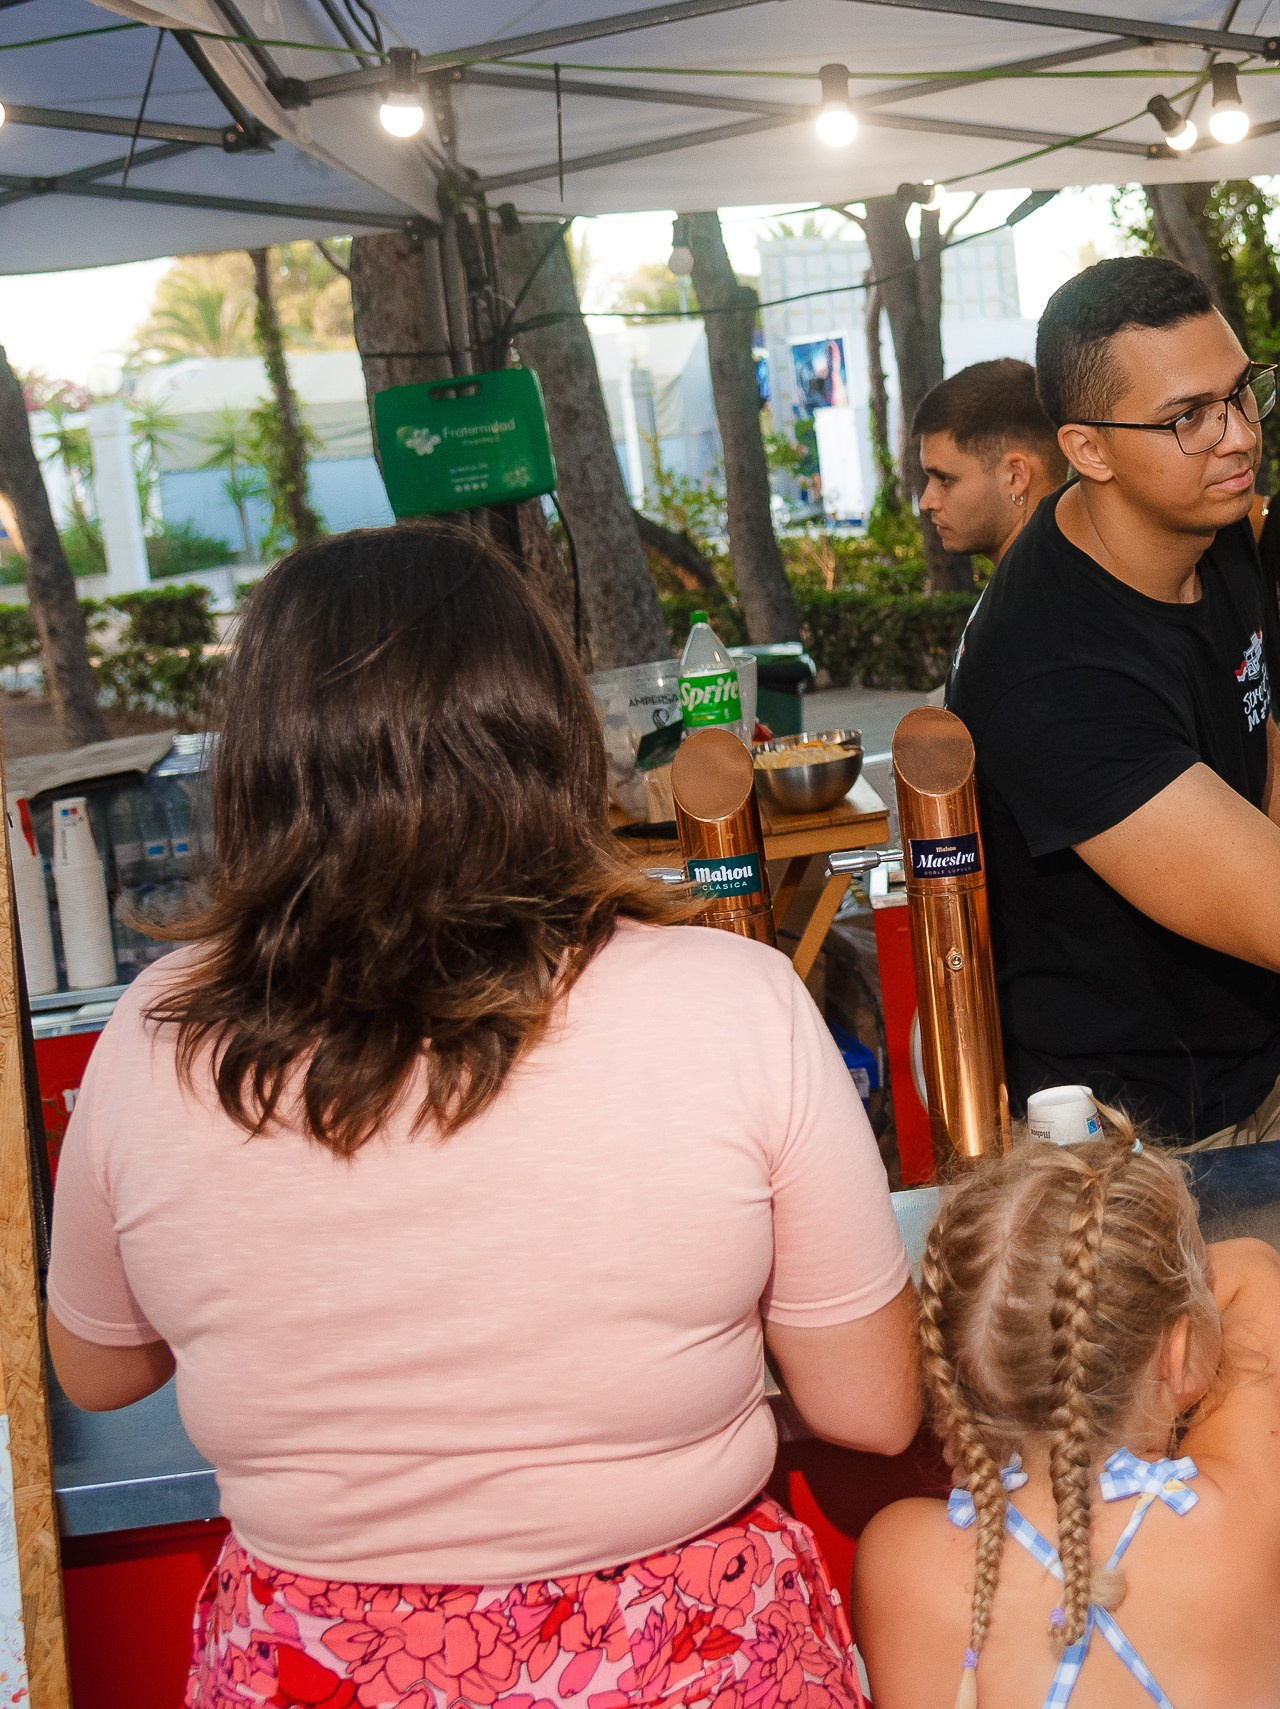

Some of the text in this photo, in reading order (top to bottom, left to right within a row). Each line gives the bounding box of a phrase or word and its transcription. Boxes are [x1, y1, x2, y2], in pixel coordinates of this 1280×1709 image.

[680, 677, 739, 711] Sprite
[916, 851, 975, 868] Maestra
[694, 865, 754, 883] Mahou
[702, 881, 748, 891] CLASICA
